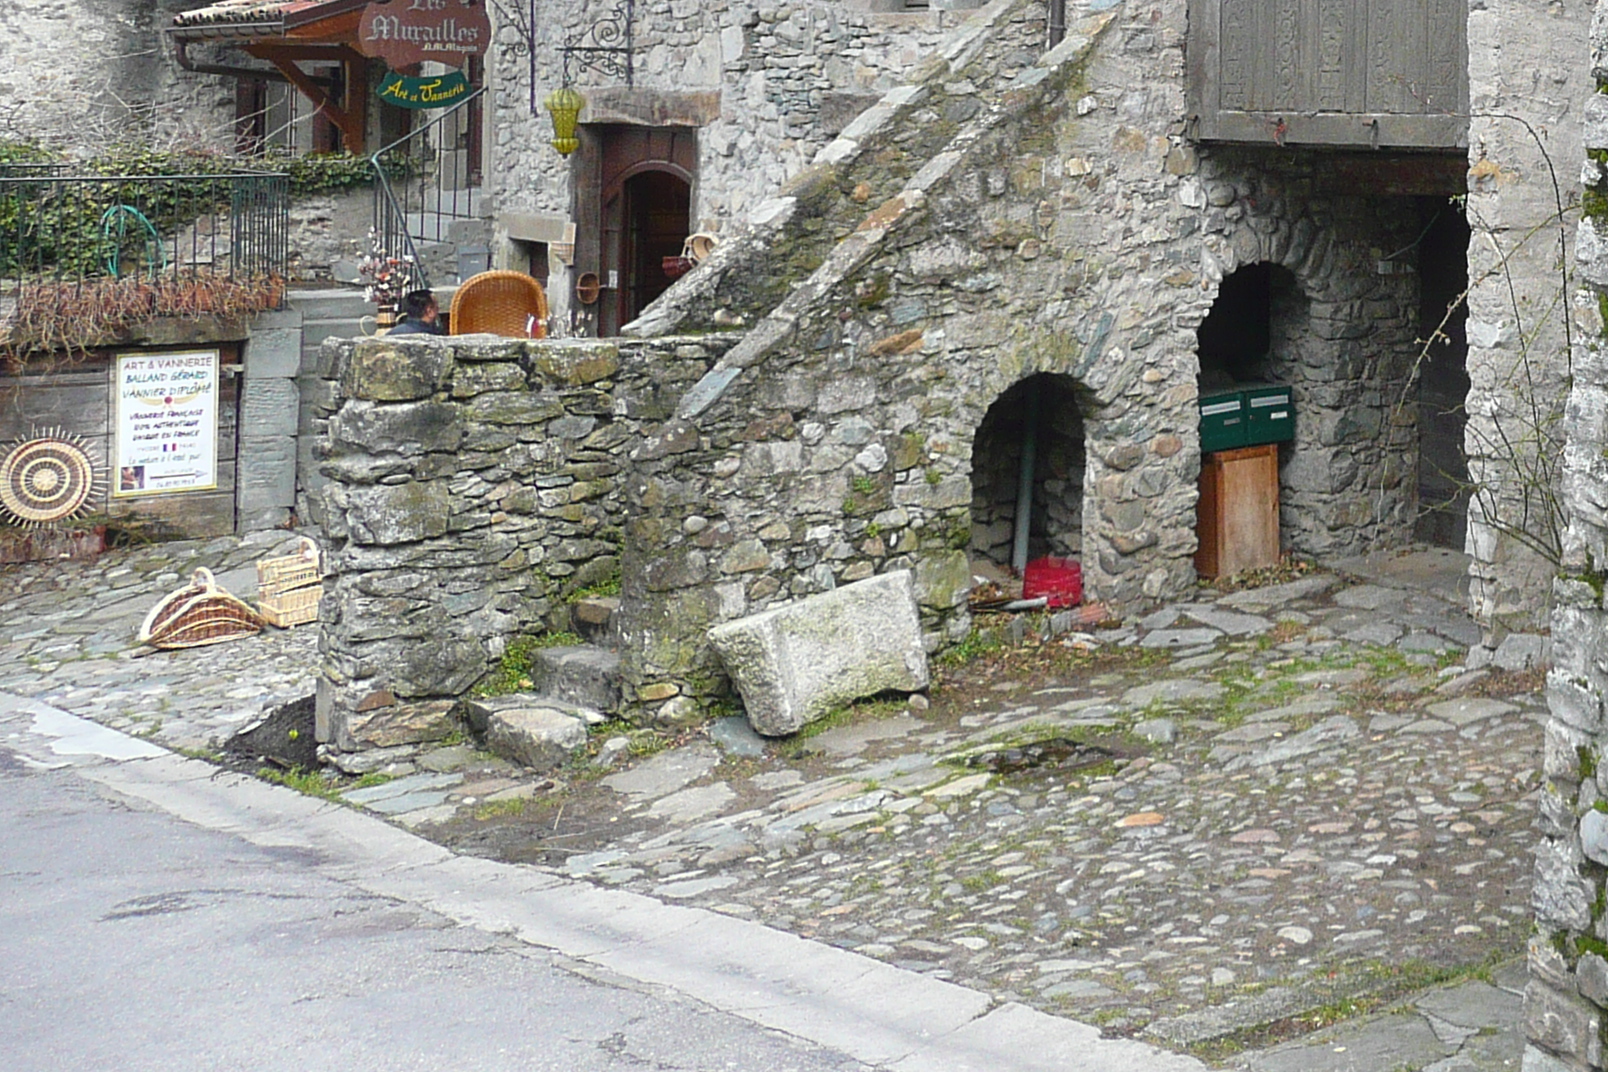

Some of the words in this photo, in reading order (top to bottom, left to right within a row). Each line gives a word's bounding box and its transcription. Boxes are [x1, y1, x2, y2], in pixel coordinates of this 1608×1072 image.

[365, 15, 478, 45] Murailles
[381, 79, 408, 99] Art
[124, 361, 145, 370] ART
[158, 357, 212, 369] VANNERIE
[125, 373, 167, 384] BALLAND
[123, 387, 166, 398] VANNIER
